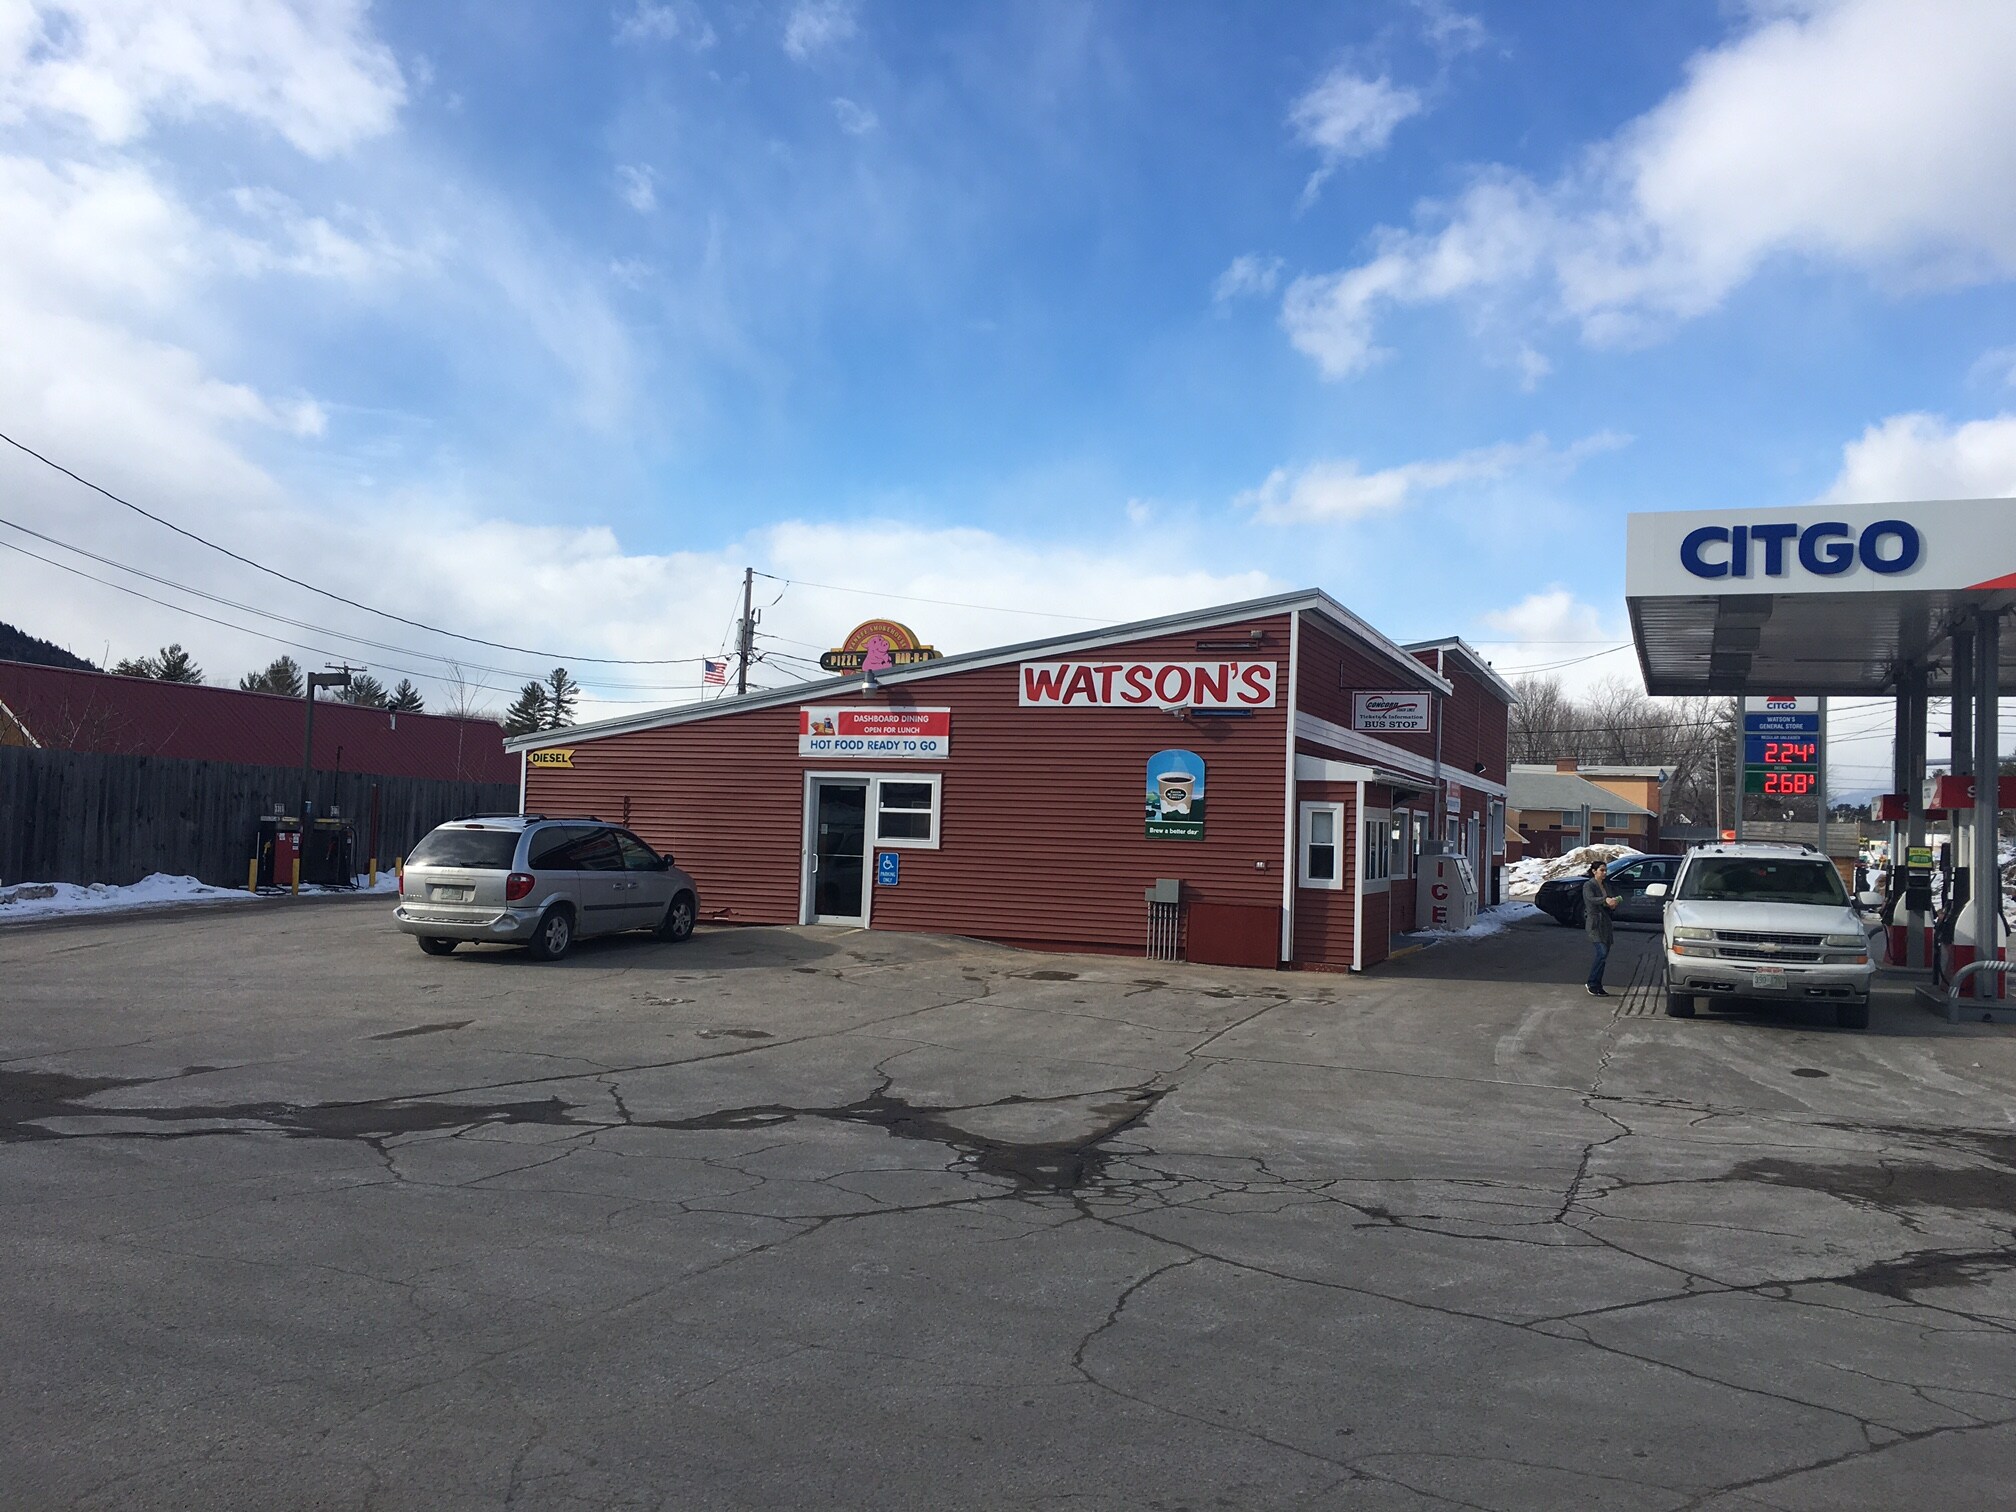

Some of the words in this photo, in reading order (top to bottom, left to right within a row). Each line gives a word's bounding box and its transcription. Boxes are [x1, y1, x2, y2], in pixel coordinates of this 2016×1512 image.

[1680, 519, 1920, 578] CITGO
[869, 625, 907, 649] SMOKEHOUSE
[830, 655, 858, 666] PIZZA
[1024, 662, 1271, 704] WATSON'S
[853, 715, 900, 723] DASHBOARD
[901, 715, 929, 723] DINING
[864, 726, 882, 734] OPEN
[883, 726, 896, 734] FOR
[810, 740, 832, 749] HOT
[834, 740, 864, 750] FOOD
[867, 740, 900, 750] READY
[903, 740, 917, 750] TO
[919, 740, 937, 751] GO
[532, 753, 568, 763] DIESEL
[1186, 828, 1200, 836] day
[1431, 861, 1449, 924] ICE
